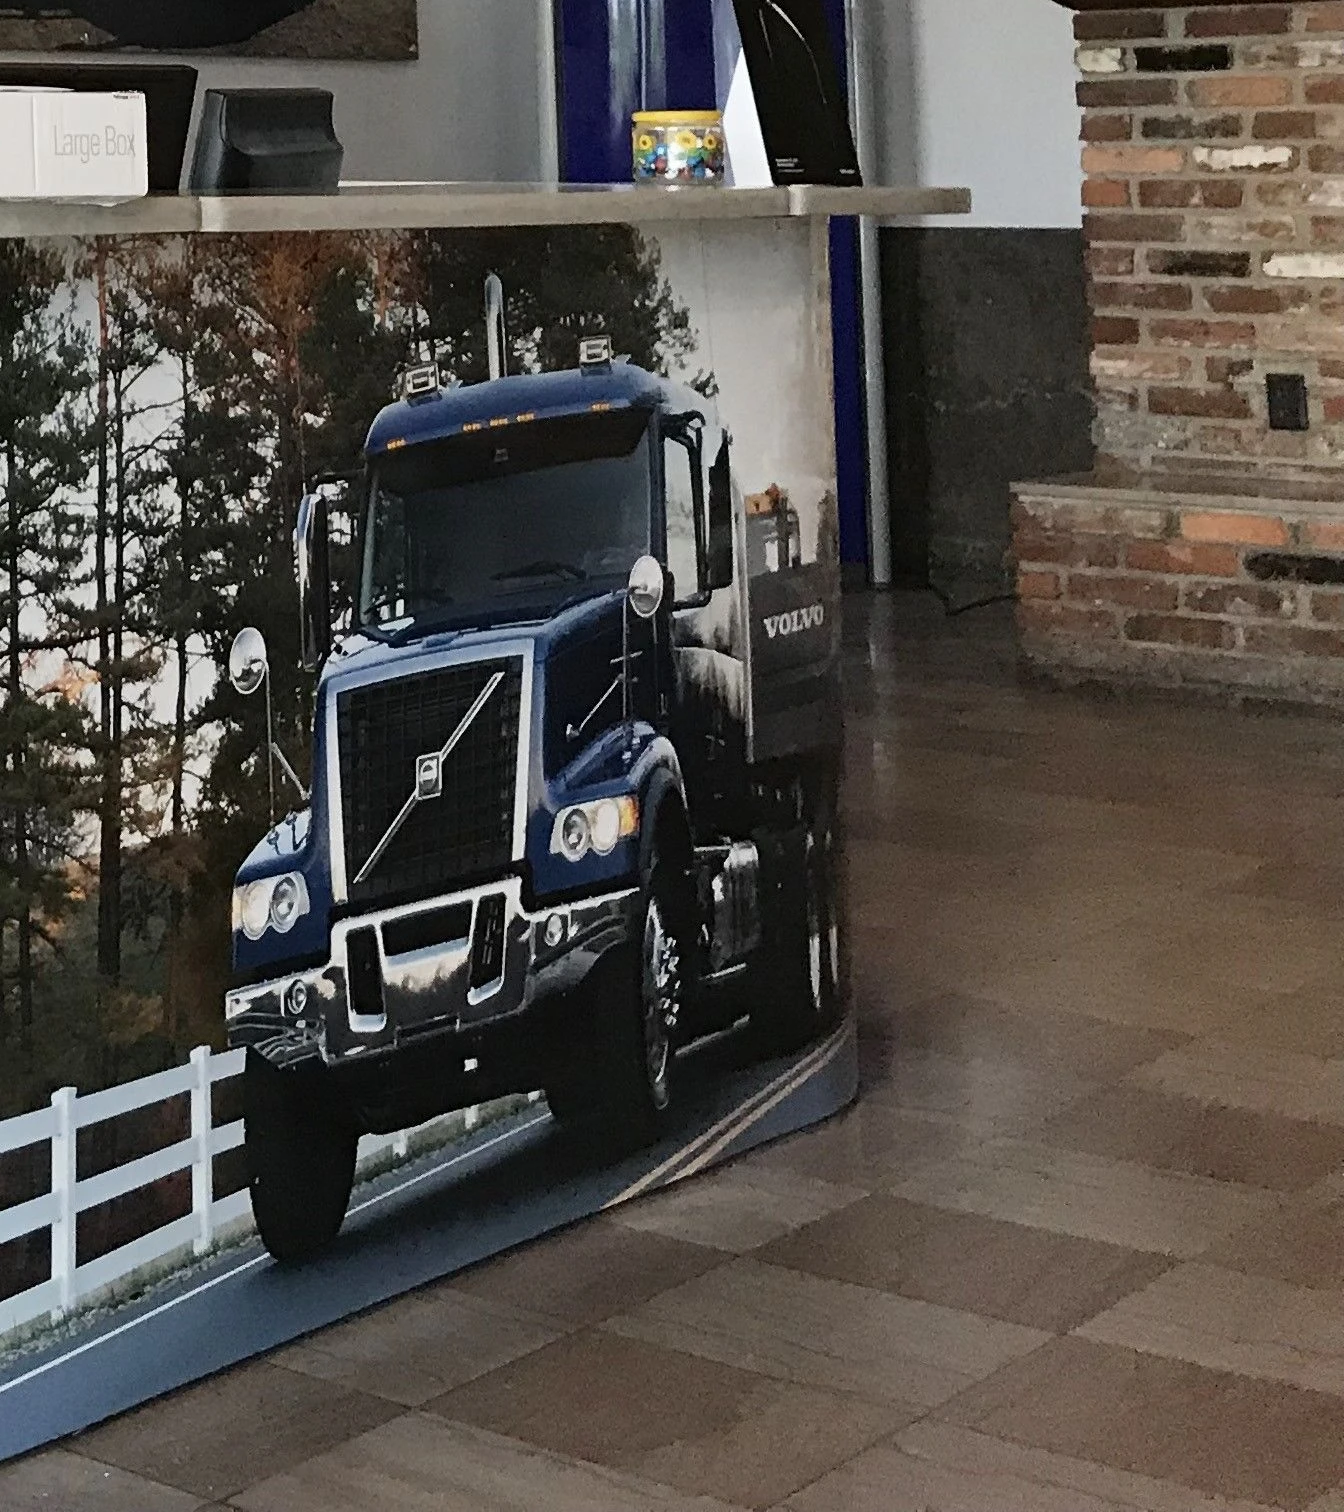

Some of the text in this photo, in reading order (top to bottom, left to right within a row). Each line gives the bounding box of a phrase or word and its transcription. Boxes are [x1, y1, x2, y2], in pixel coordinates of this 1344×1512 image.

[53, 124, 136, 163] Large Box
[763, 604, 824, 639] VOLVO
